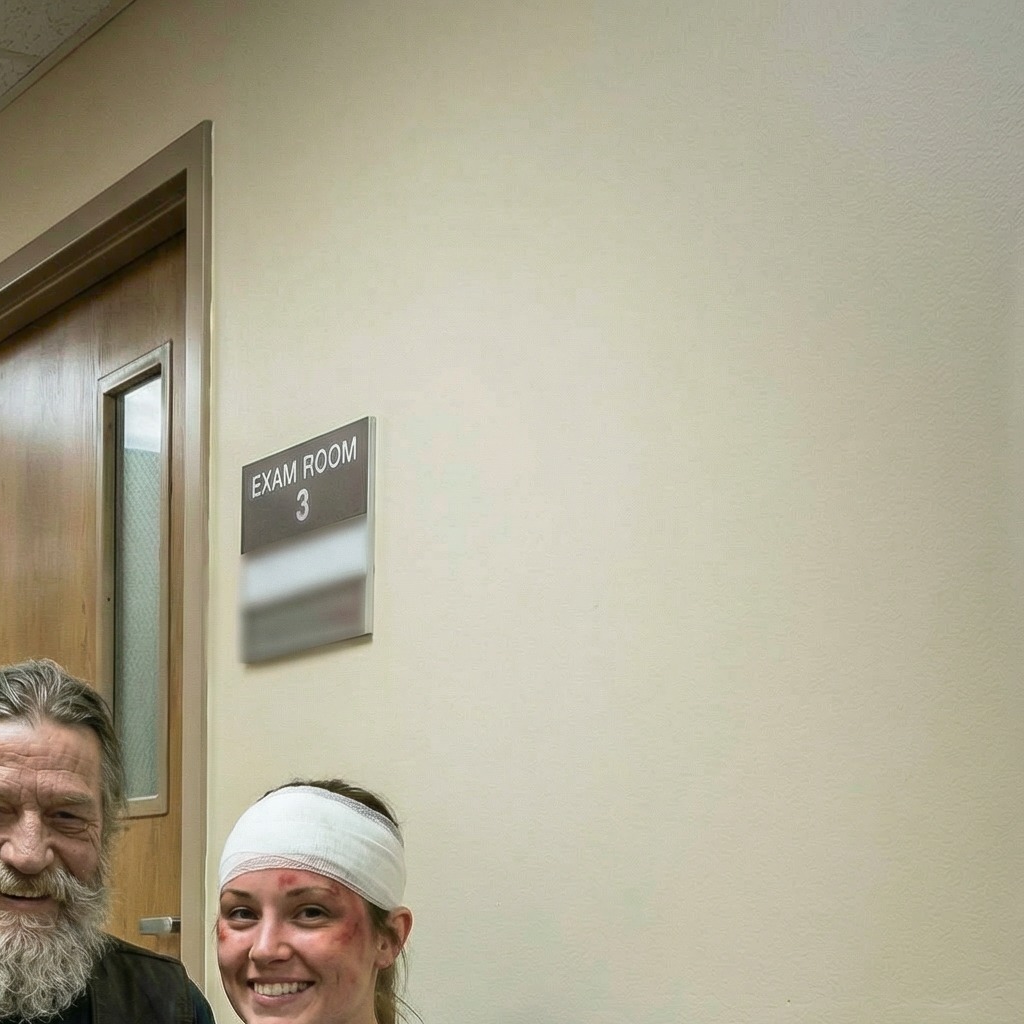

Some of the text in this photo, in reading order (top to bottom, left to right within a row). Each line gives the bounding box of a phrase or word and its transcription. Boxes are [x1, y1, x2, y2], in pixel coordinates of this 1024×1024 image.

[252, 436, 357, 499] EXAM ROOM
[296, 488, 310, 522] 3
